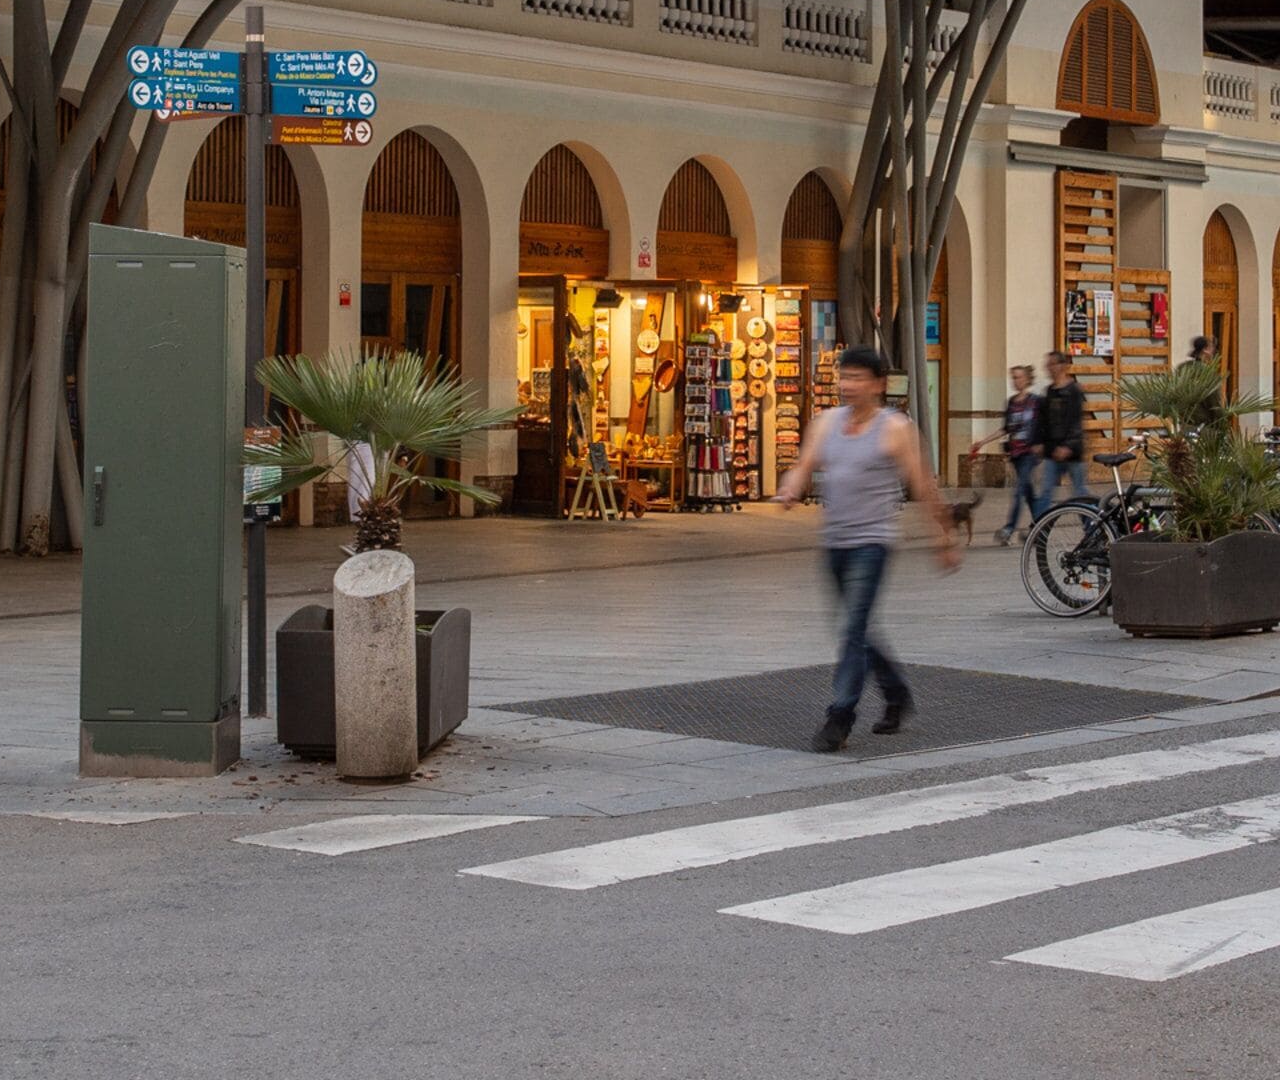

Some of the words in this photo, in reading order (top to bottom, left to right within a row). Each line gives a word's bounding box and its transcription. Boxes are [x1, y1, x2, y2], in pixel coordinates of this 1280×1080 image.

[173, 49, 188, 58] Sant
[283, 53, 296, 62] Sant
[296, 53, 309, 61] Pere
[173, 60, 188, 68] Sant
[288, 63, 301, 71] Sant
[301, 63, 314, 71] Pere
[204, 84, 234, 95] Companys
